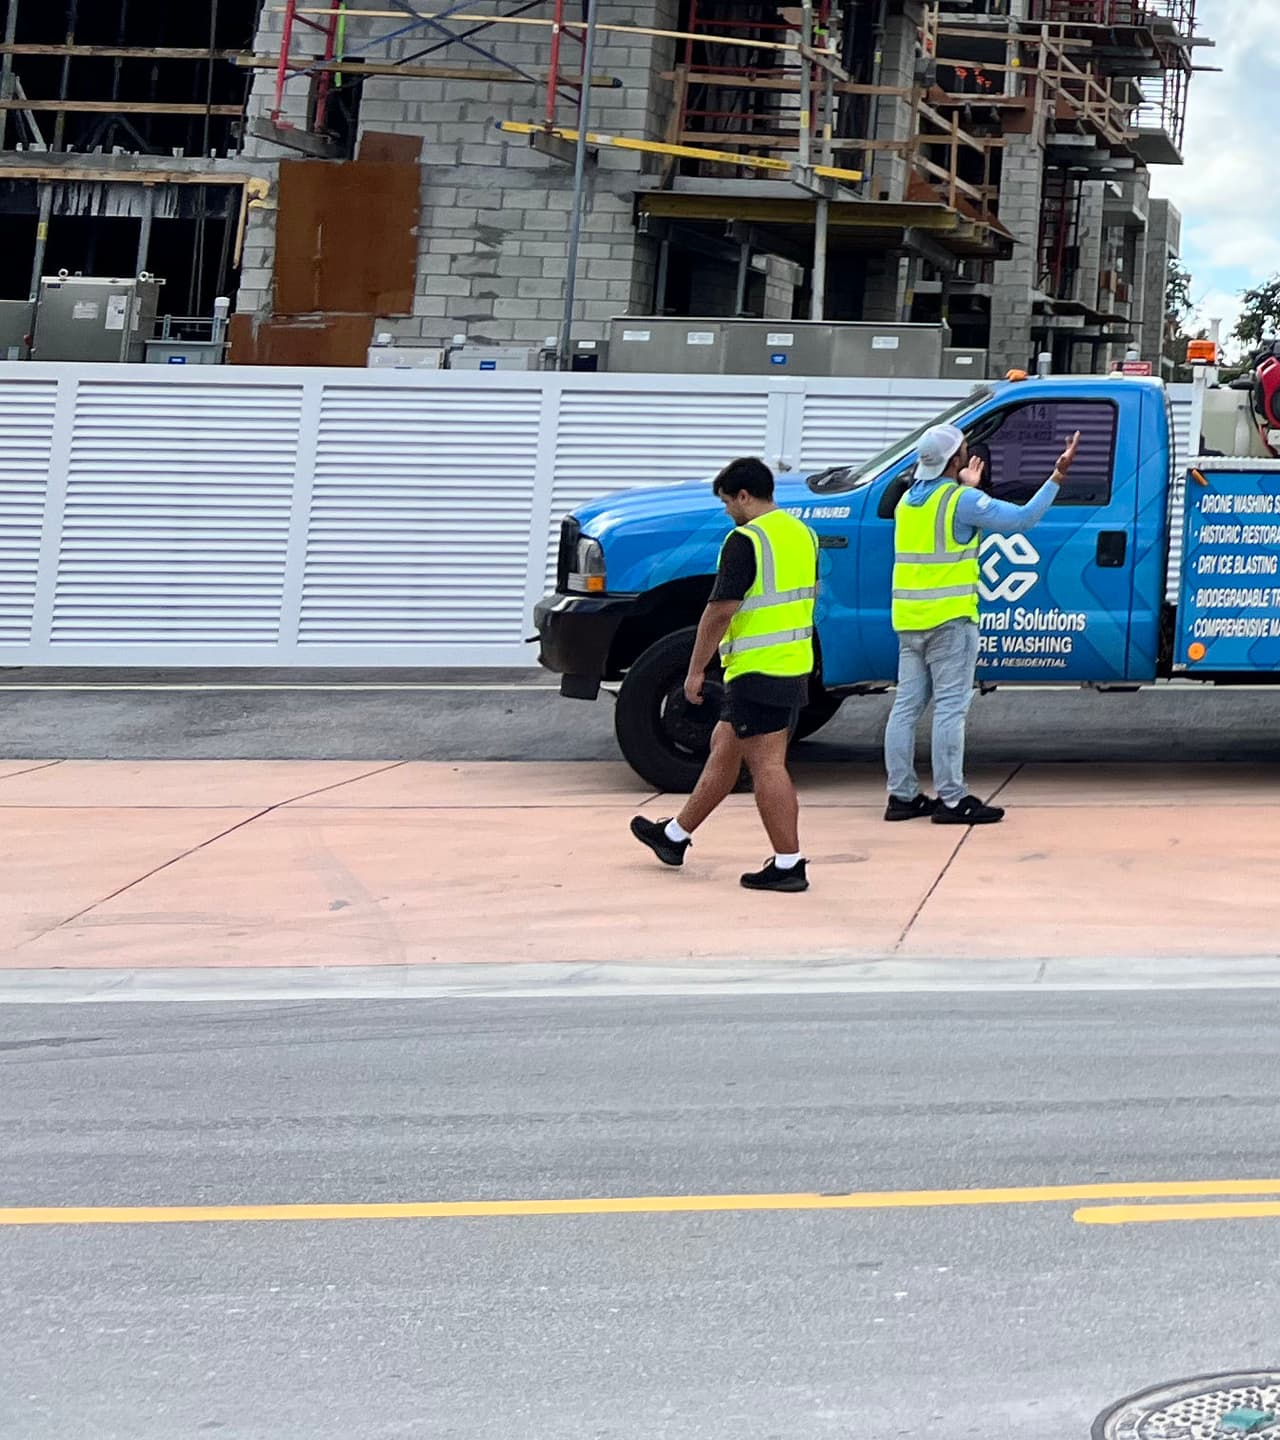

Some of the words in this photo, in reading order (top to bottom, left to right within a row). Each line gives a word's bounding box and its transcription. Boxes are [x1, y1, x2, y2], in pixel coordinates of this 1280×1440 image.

[803, 507, 811, 518] &
[811, 506, 851, 518] INSURED
[1201, 494, 1233, 513] DRONE
[1233, 494, 1273, 513] WASHING
[1199, 525, 1241, 544] HISTORIC
[1197, 555, 1218, 574] DRY
[1217, 555, 1234, 574] ICE
[1233, 555, 1278, 574] BLASTING
[1196, 588, 1269, 608] BIODEGRADABLE
[979, 607, 1010, 630] rnal
[1012, 607, 1087, 631] Solutions
[1193, 618, 1270, 638] COMPREHENSIVE
[976, 636, 999, 652] RE
[1001, 636, 1073, 653] WASHING
[991, 658, 999, 667] &
[1000, 658, 1067, 668] RESIDENTIAL
